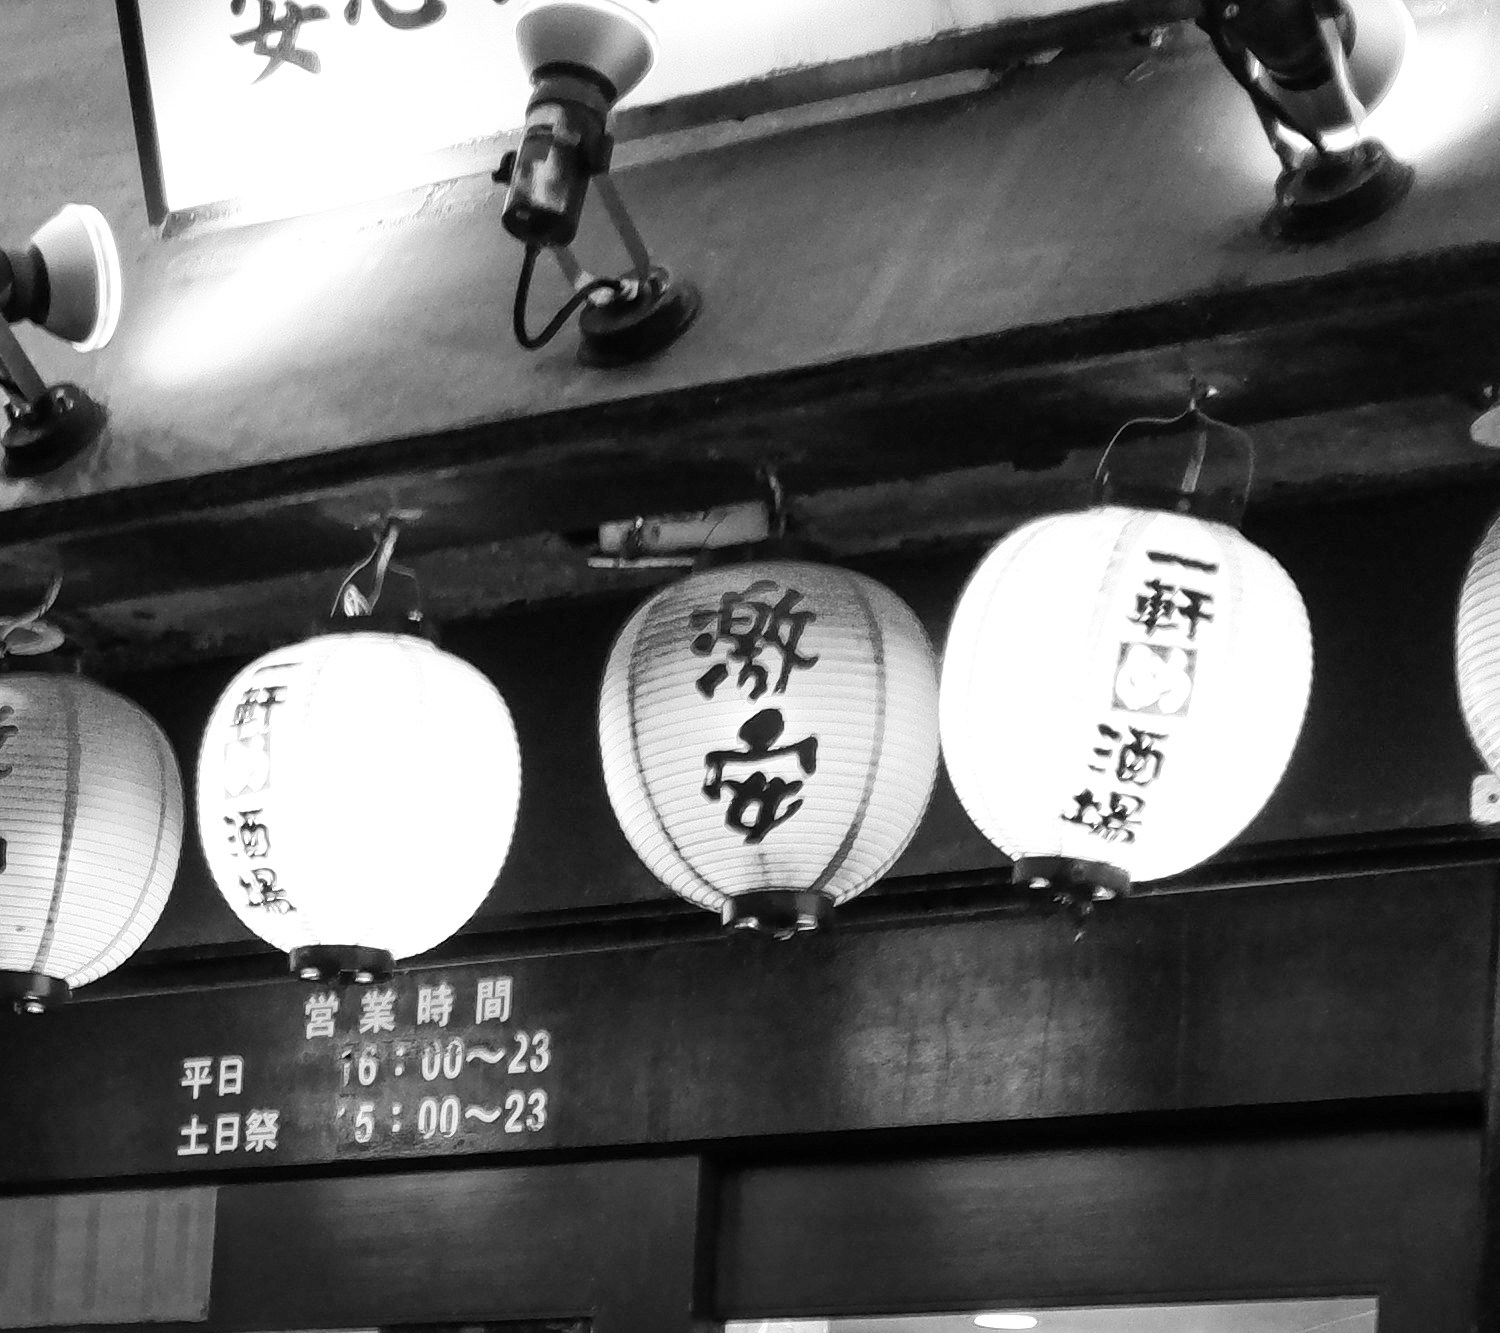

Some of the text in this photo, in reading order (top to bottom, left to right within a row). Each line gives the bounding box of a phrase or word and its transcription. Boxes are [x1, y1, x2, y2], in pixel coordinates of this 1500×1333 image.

[690, 579, 819, 845] 激安
[1060, 547, 1221, 846] 一軒め酒場
[304, 975, 514, 1040] 営業時間
[180, 1053, 245, 1100] 平日
[176, 1107, 281, 1156] 土日祭
